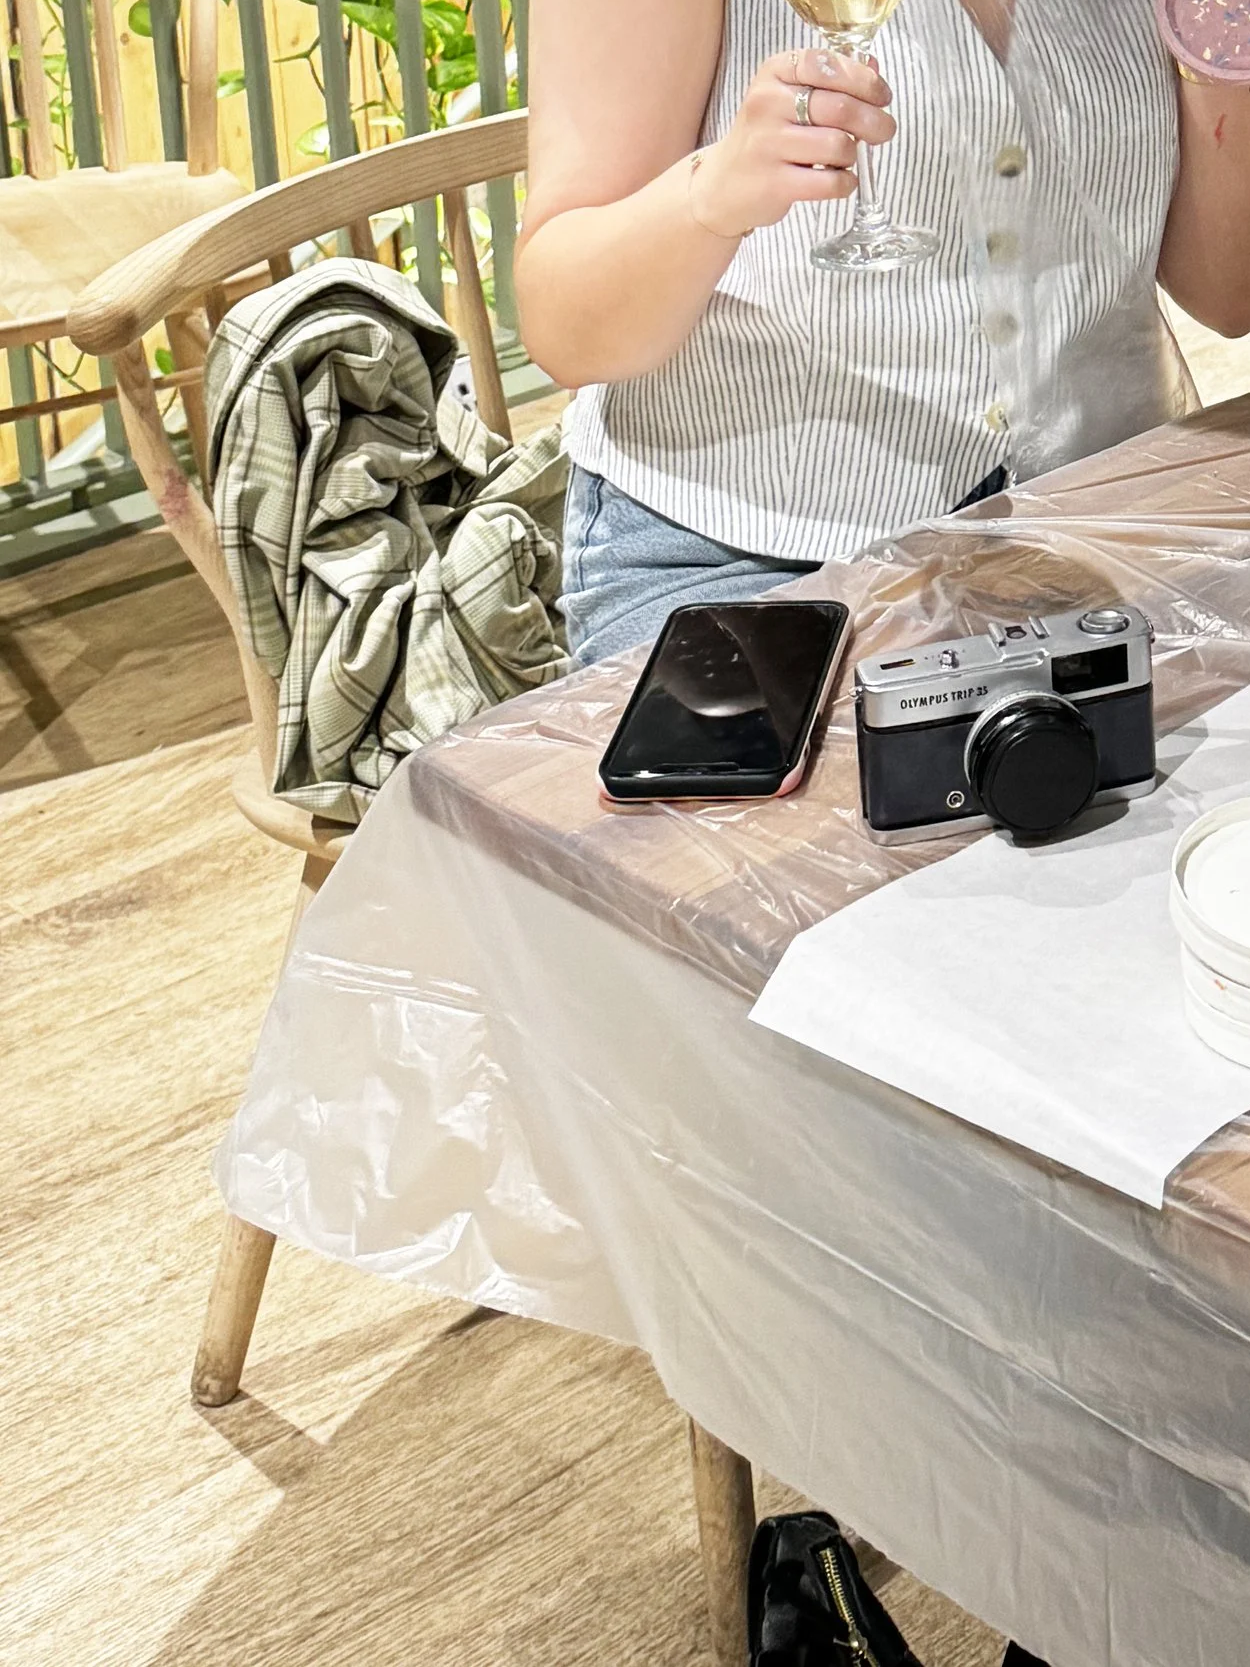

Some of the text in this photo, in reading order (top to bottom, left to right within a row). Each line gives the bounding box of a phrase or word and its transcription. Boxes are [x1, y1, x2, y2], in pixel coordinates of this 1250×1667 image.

[900, 686, 988, 709] OLYMPUS TRIP 35
